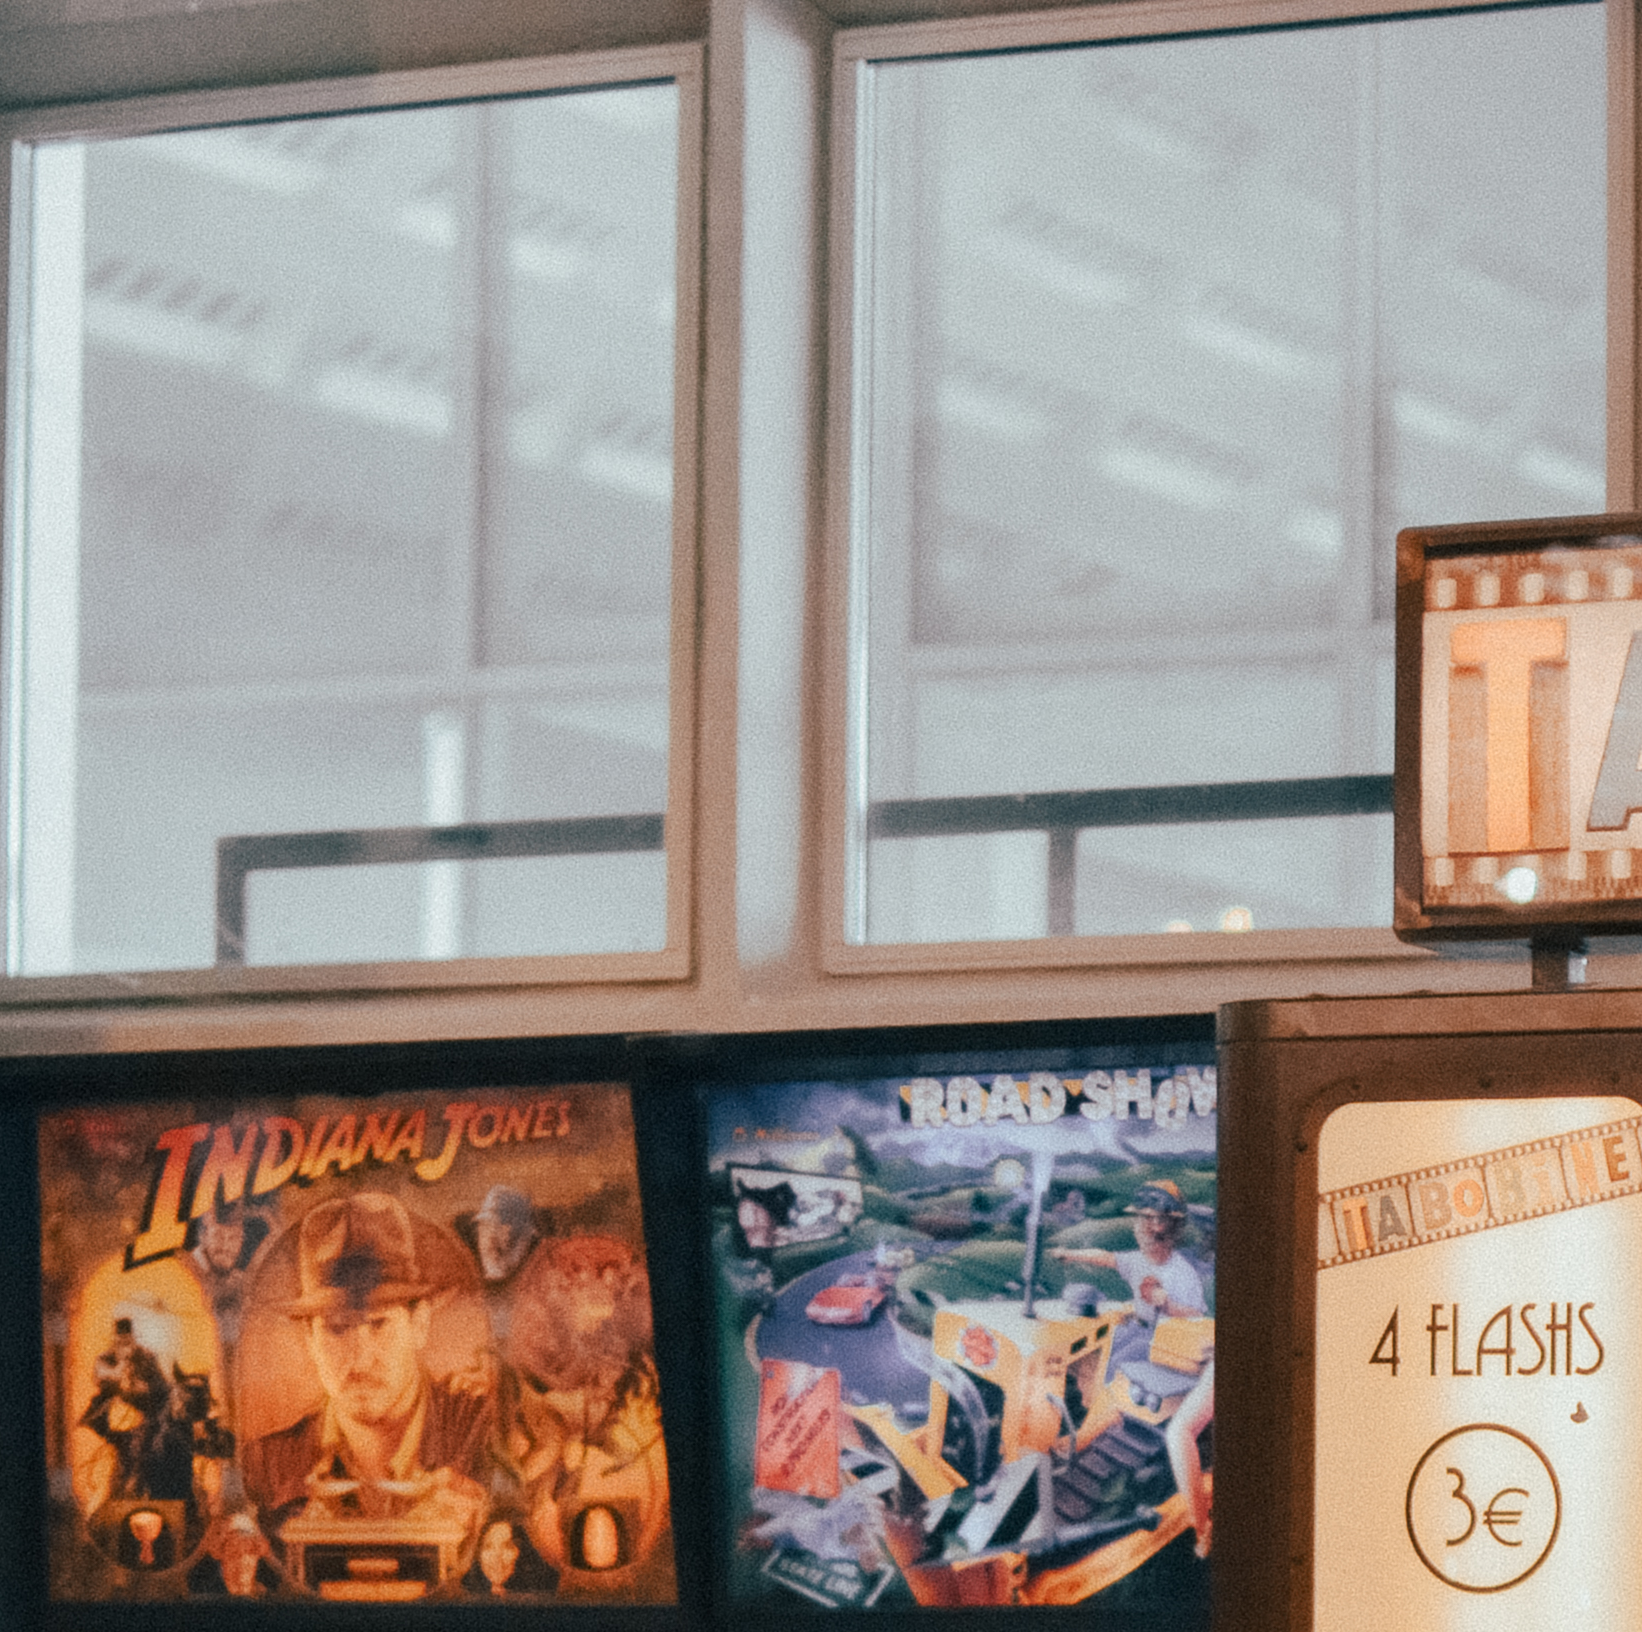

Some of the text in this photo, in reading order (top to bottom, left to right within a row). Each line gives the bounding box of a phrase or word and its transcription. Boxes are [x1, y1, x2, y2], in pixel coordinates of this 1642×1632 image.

[910, 1071, 1066, 1129] ROAD
[129, 1100, 572, 1266] INDIANA JONES
[1368, 1301, 1606, 1378] 4 FLASHS
[1445, 1466, 1530, 1548] 3€
